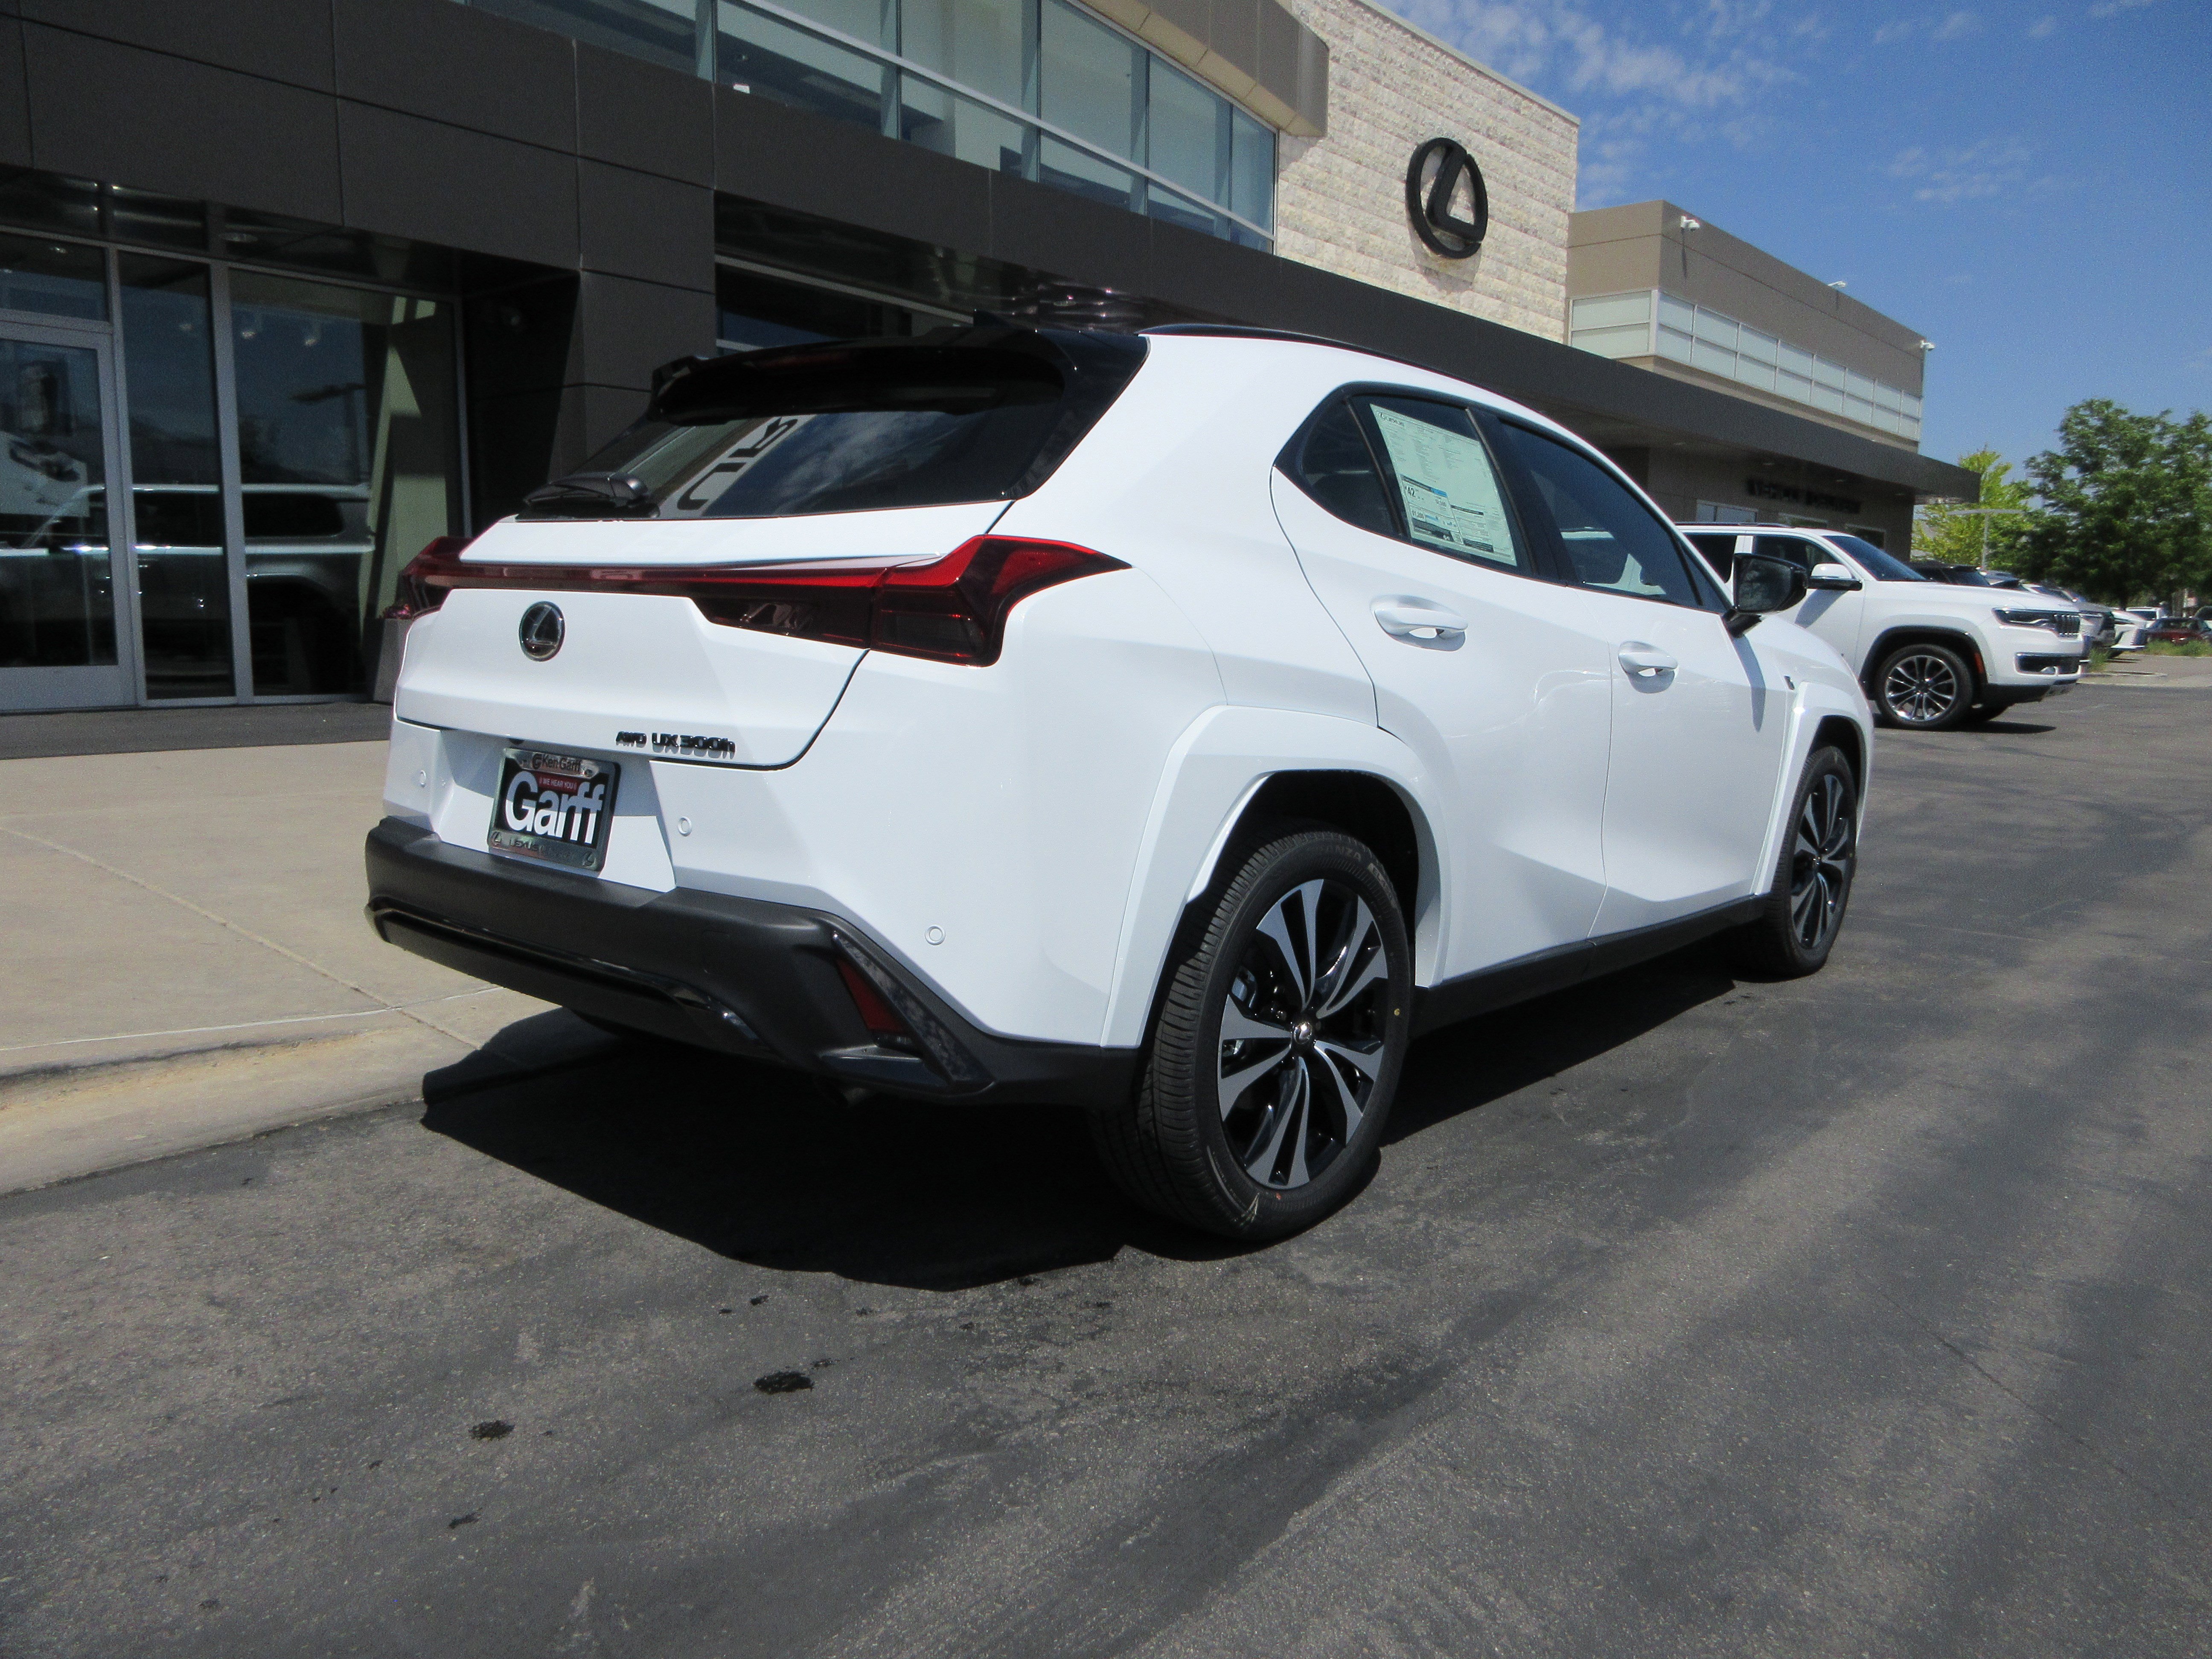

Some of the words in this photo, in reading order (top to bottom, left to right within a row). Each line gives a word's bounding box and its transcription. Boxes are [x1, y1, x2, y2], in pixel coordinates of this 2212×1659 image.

[551, 779, 563, 788] HEAR
[564, 781, 574, 789] YOU
[505, 771, 605, 844] Garff
